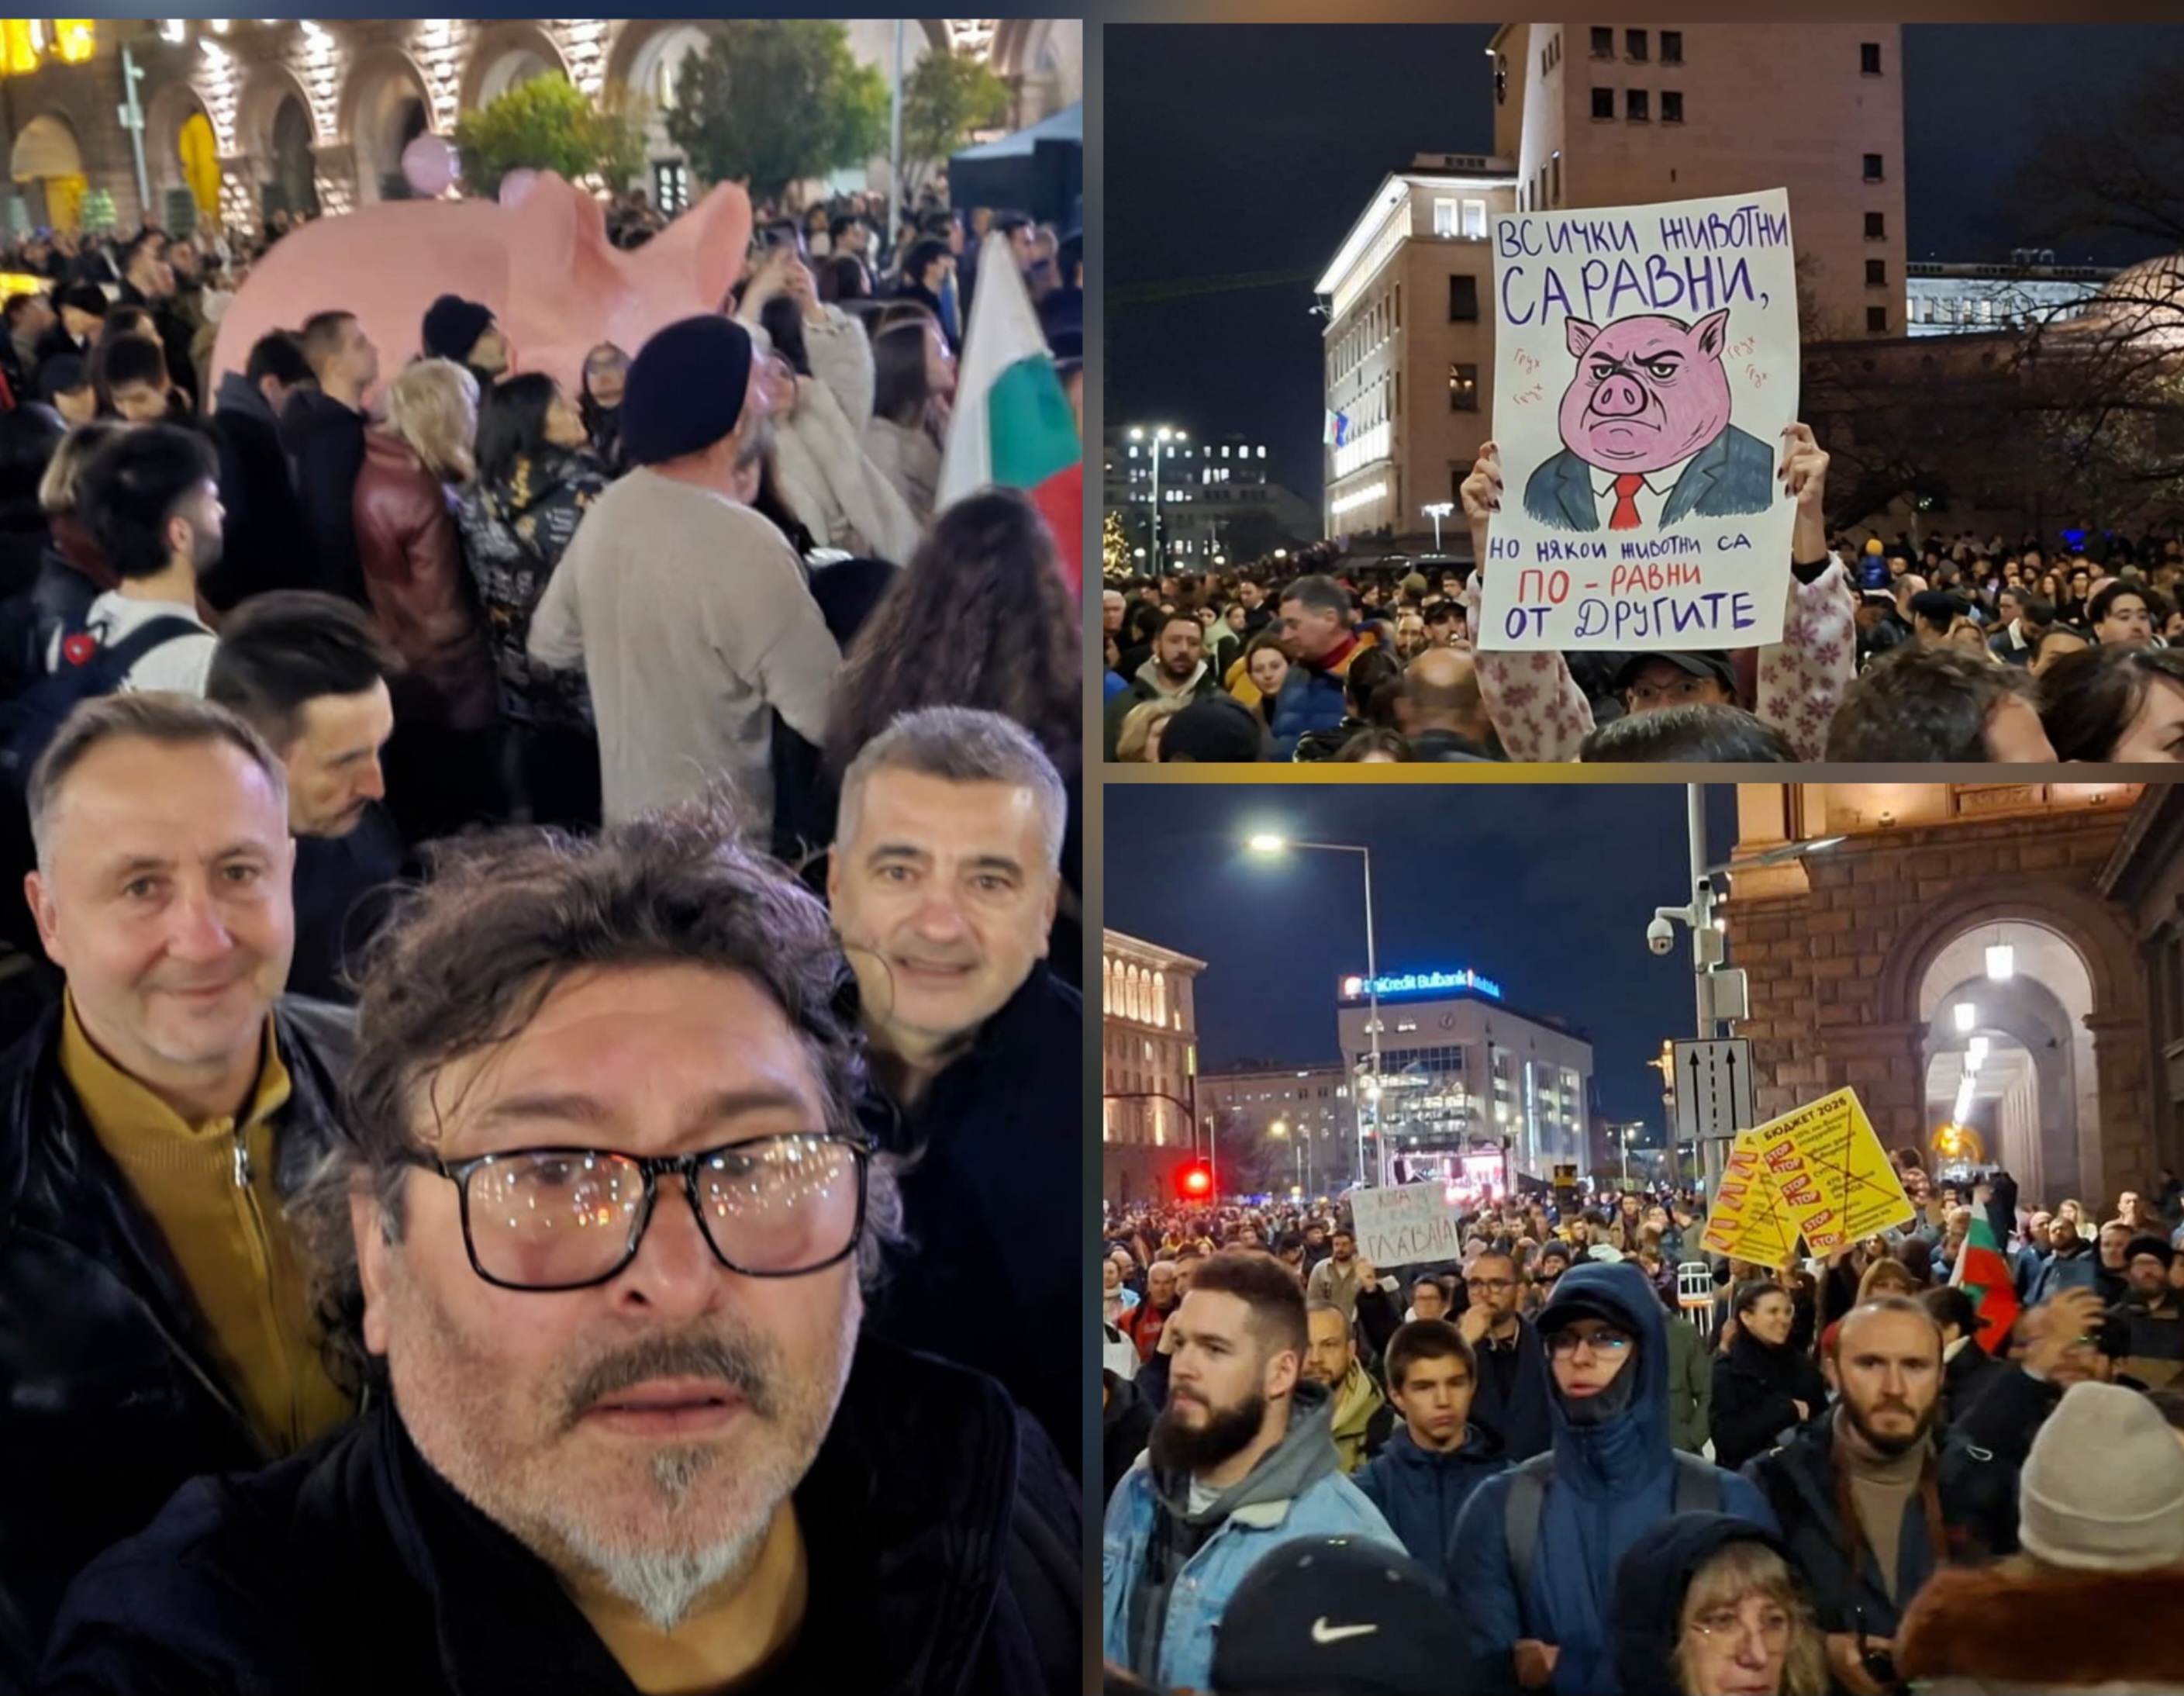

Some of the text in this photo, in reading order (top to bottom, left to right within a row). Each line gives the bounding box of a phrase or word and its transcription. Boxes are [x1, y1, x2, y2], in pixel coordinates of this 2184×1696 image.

[1498, 206, 1789, 257] ВСИЧКИ ЖИВОТНИ
[1489, 537, 1520, 559] НО
[1718, 534, 1751, 550] СА
[1506, 592, 1756, 640] ОТ ДРУГИТЕ
[1417, 970, 1467, 989] Bulbank
[1764, 1111, 1816, 1141] БЮДЖЕТ
[1765, 1142, 1790, 1162] STOP
[1773, 1159, 1801, 1174] STOP
[1783, 1176, 1808, 1195] STOP
[1789, 1192, 1817, 1207] STOP
[1804, 1211, 1828, 1231] STOP
[1811, 1233, 1840, 1248] STOP
